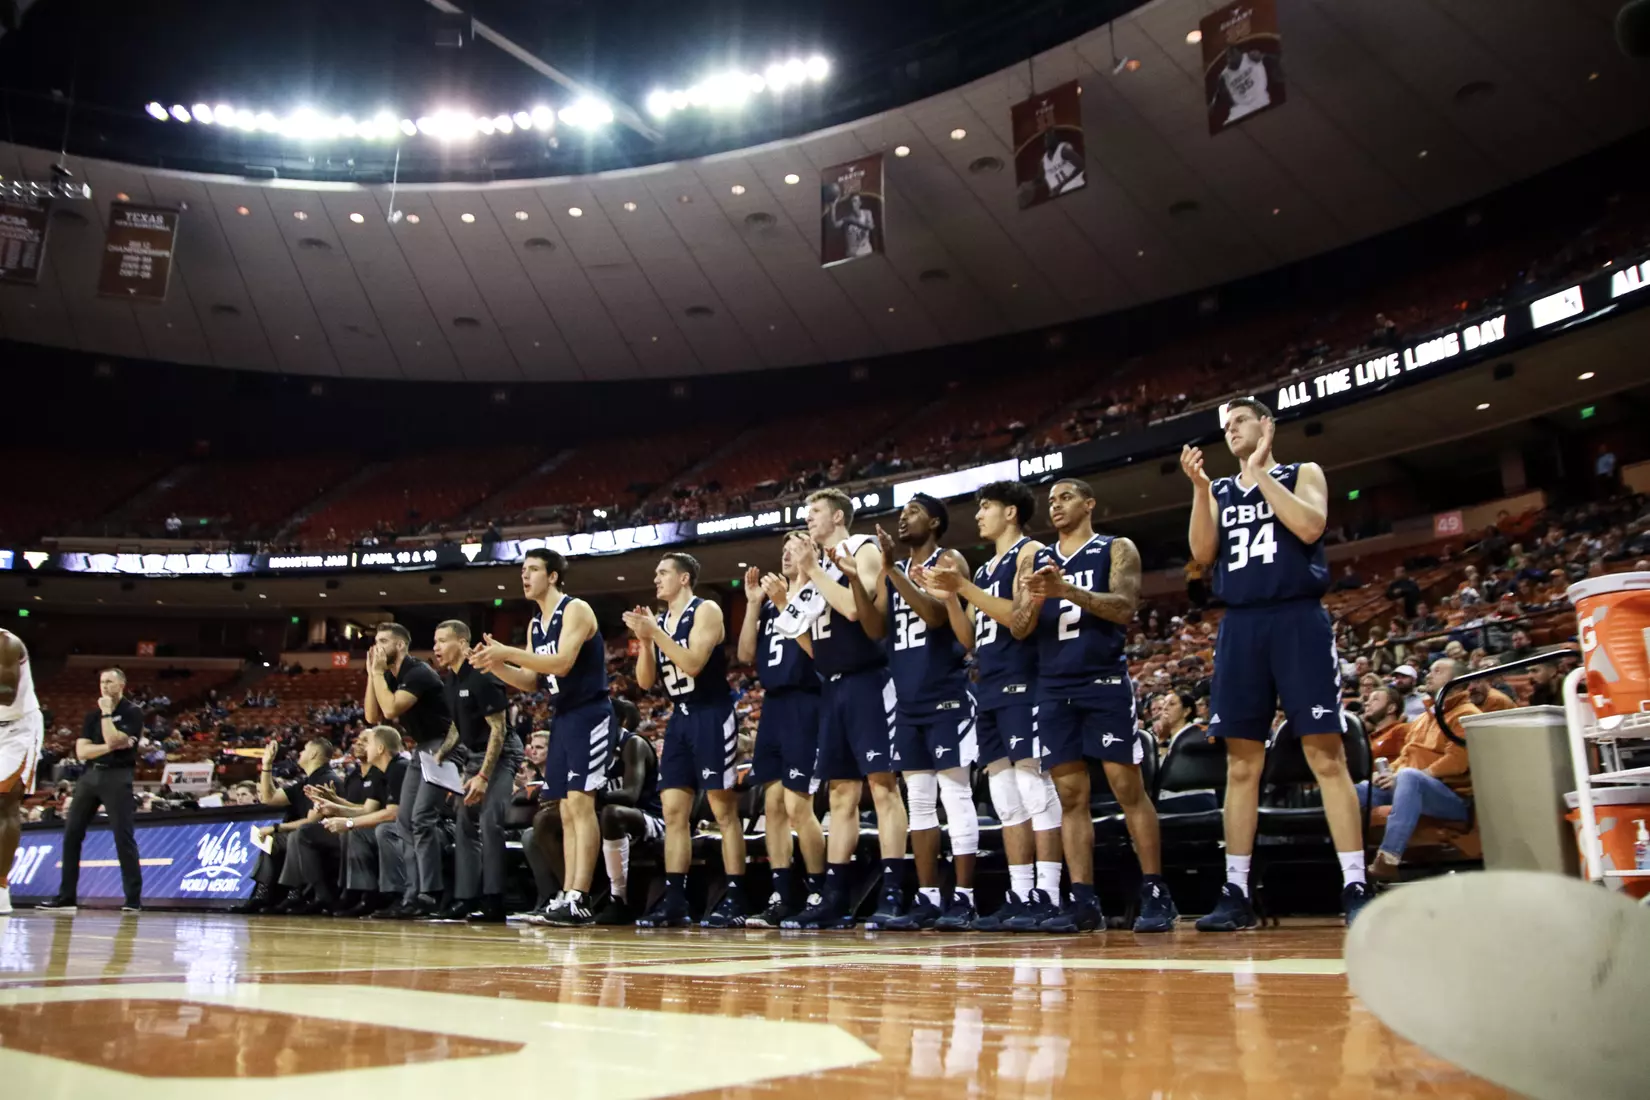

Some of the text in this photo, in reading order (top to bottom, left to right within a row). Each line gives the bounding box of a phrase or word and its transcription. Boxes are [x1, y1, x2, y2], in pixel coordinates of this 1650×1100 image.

[125, 211, 164, 224] TEXAS
[1277, 314, 1507, 410] ALL THE LIVE LONG DAY
[1221, 501, 1275, 528] CBU
[269, 556, 323, 569] MONSTER
[362, 552, 394, 565] APRIL
[1228, 522, 1278, 572] 34
[894, 610, 927, 651] 32
[1058, 599, 1081, 641] 2
[767, 634, 784, 667] 5
[197, 821, 248, 868] WinStar
[180, 878, 240, 892] WORLD RESORT
